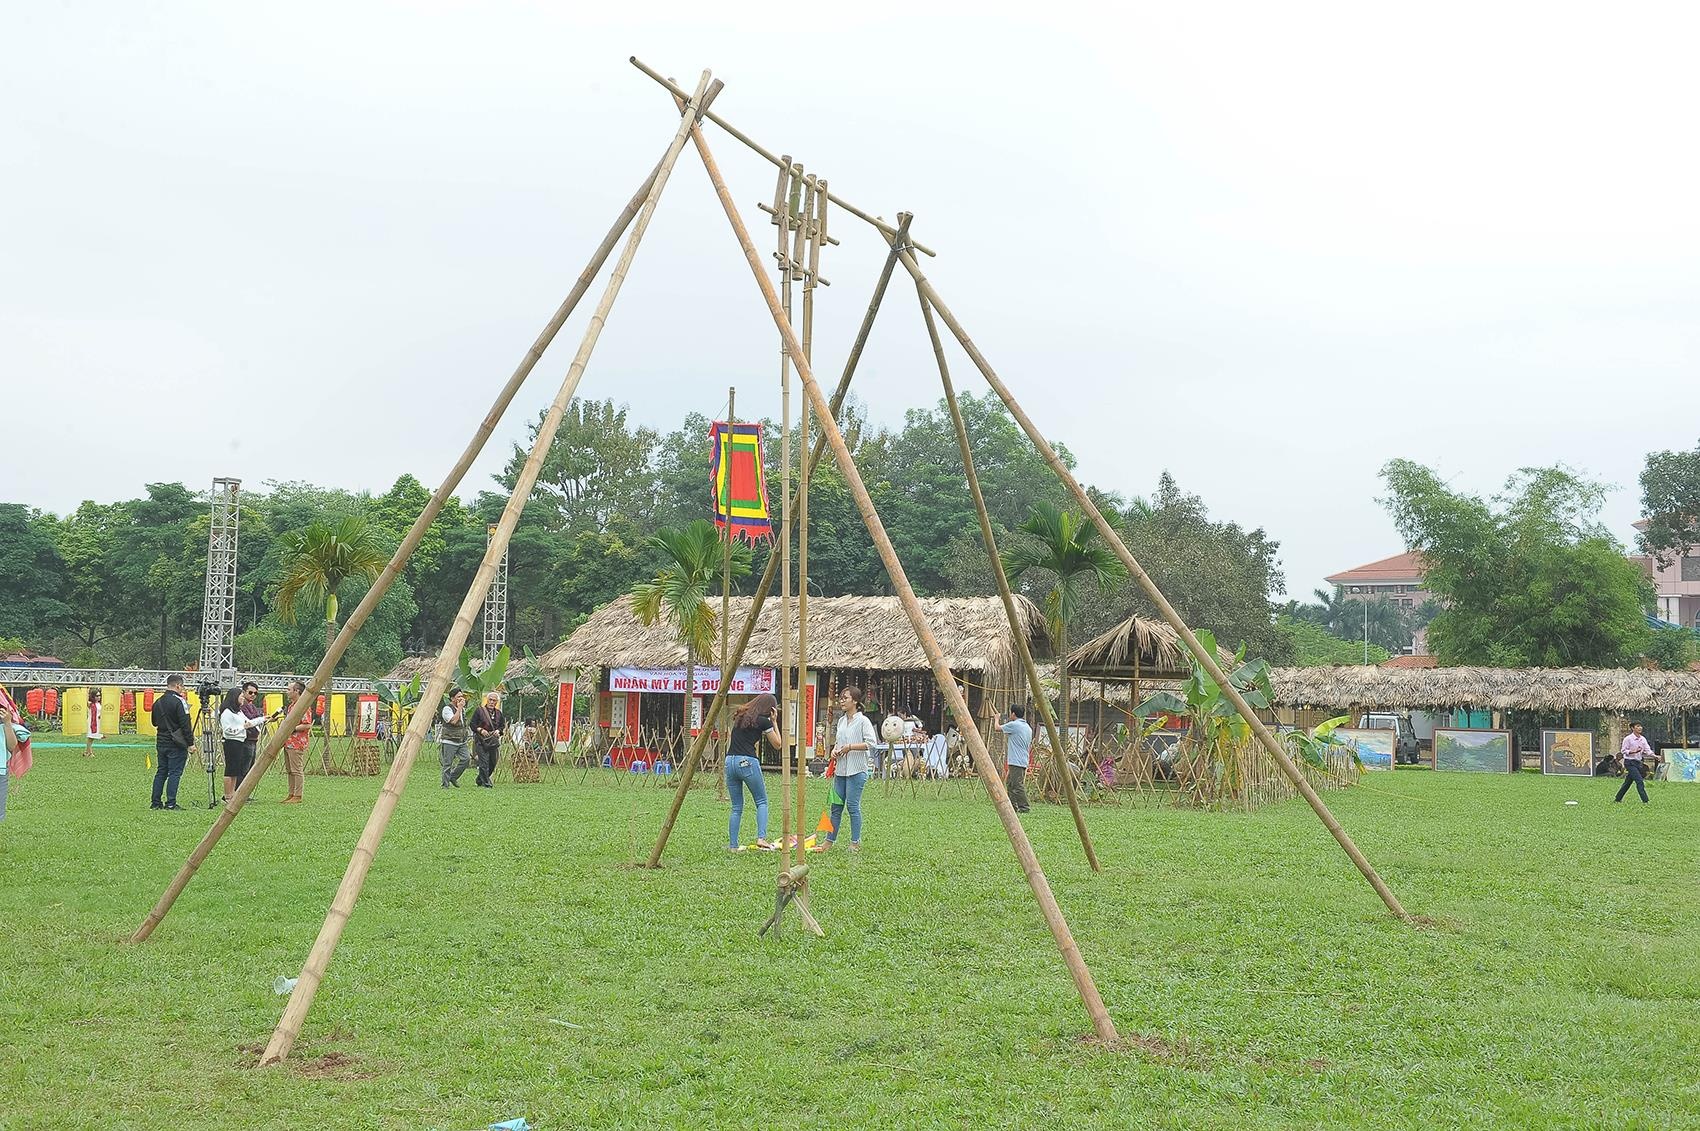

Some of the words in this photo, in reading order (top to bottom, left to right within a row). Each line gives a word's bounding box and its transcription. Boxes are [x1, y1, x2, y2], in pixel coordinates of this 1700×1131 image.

[614, 676, 648, 690] NHÂN
[651, 677, 670, 690] MỸ
[701, 679, 744, 692] ĐƯNG
